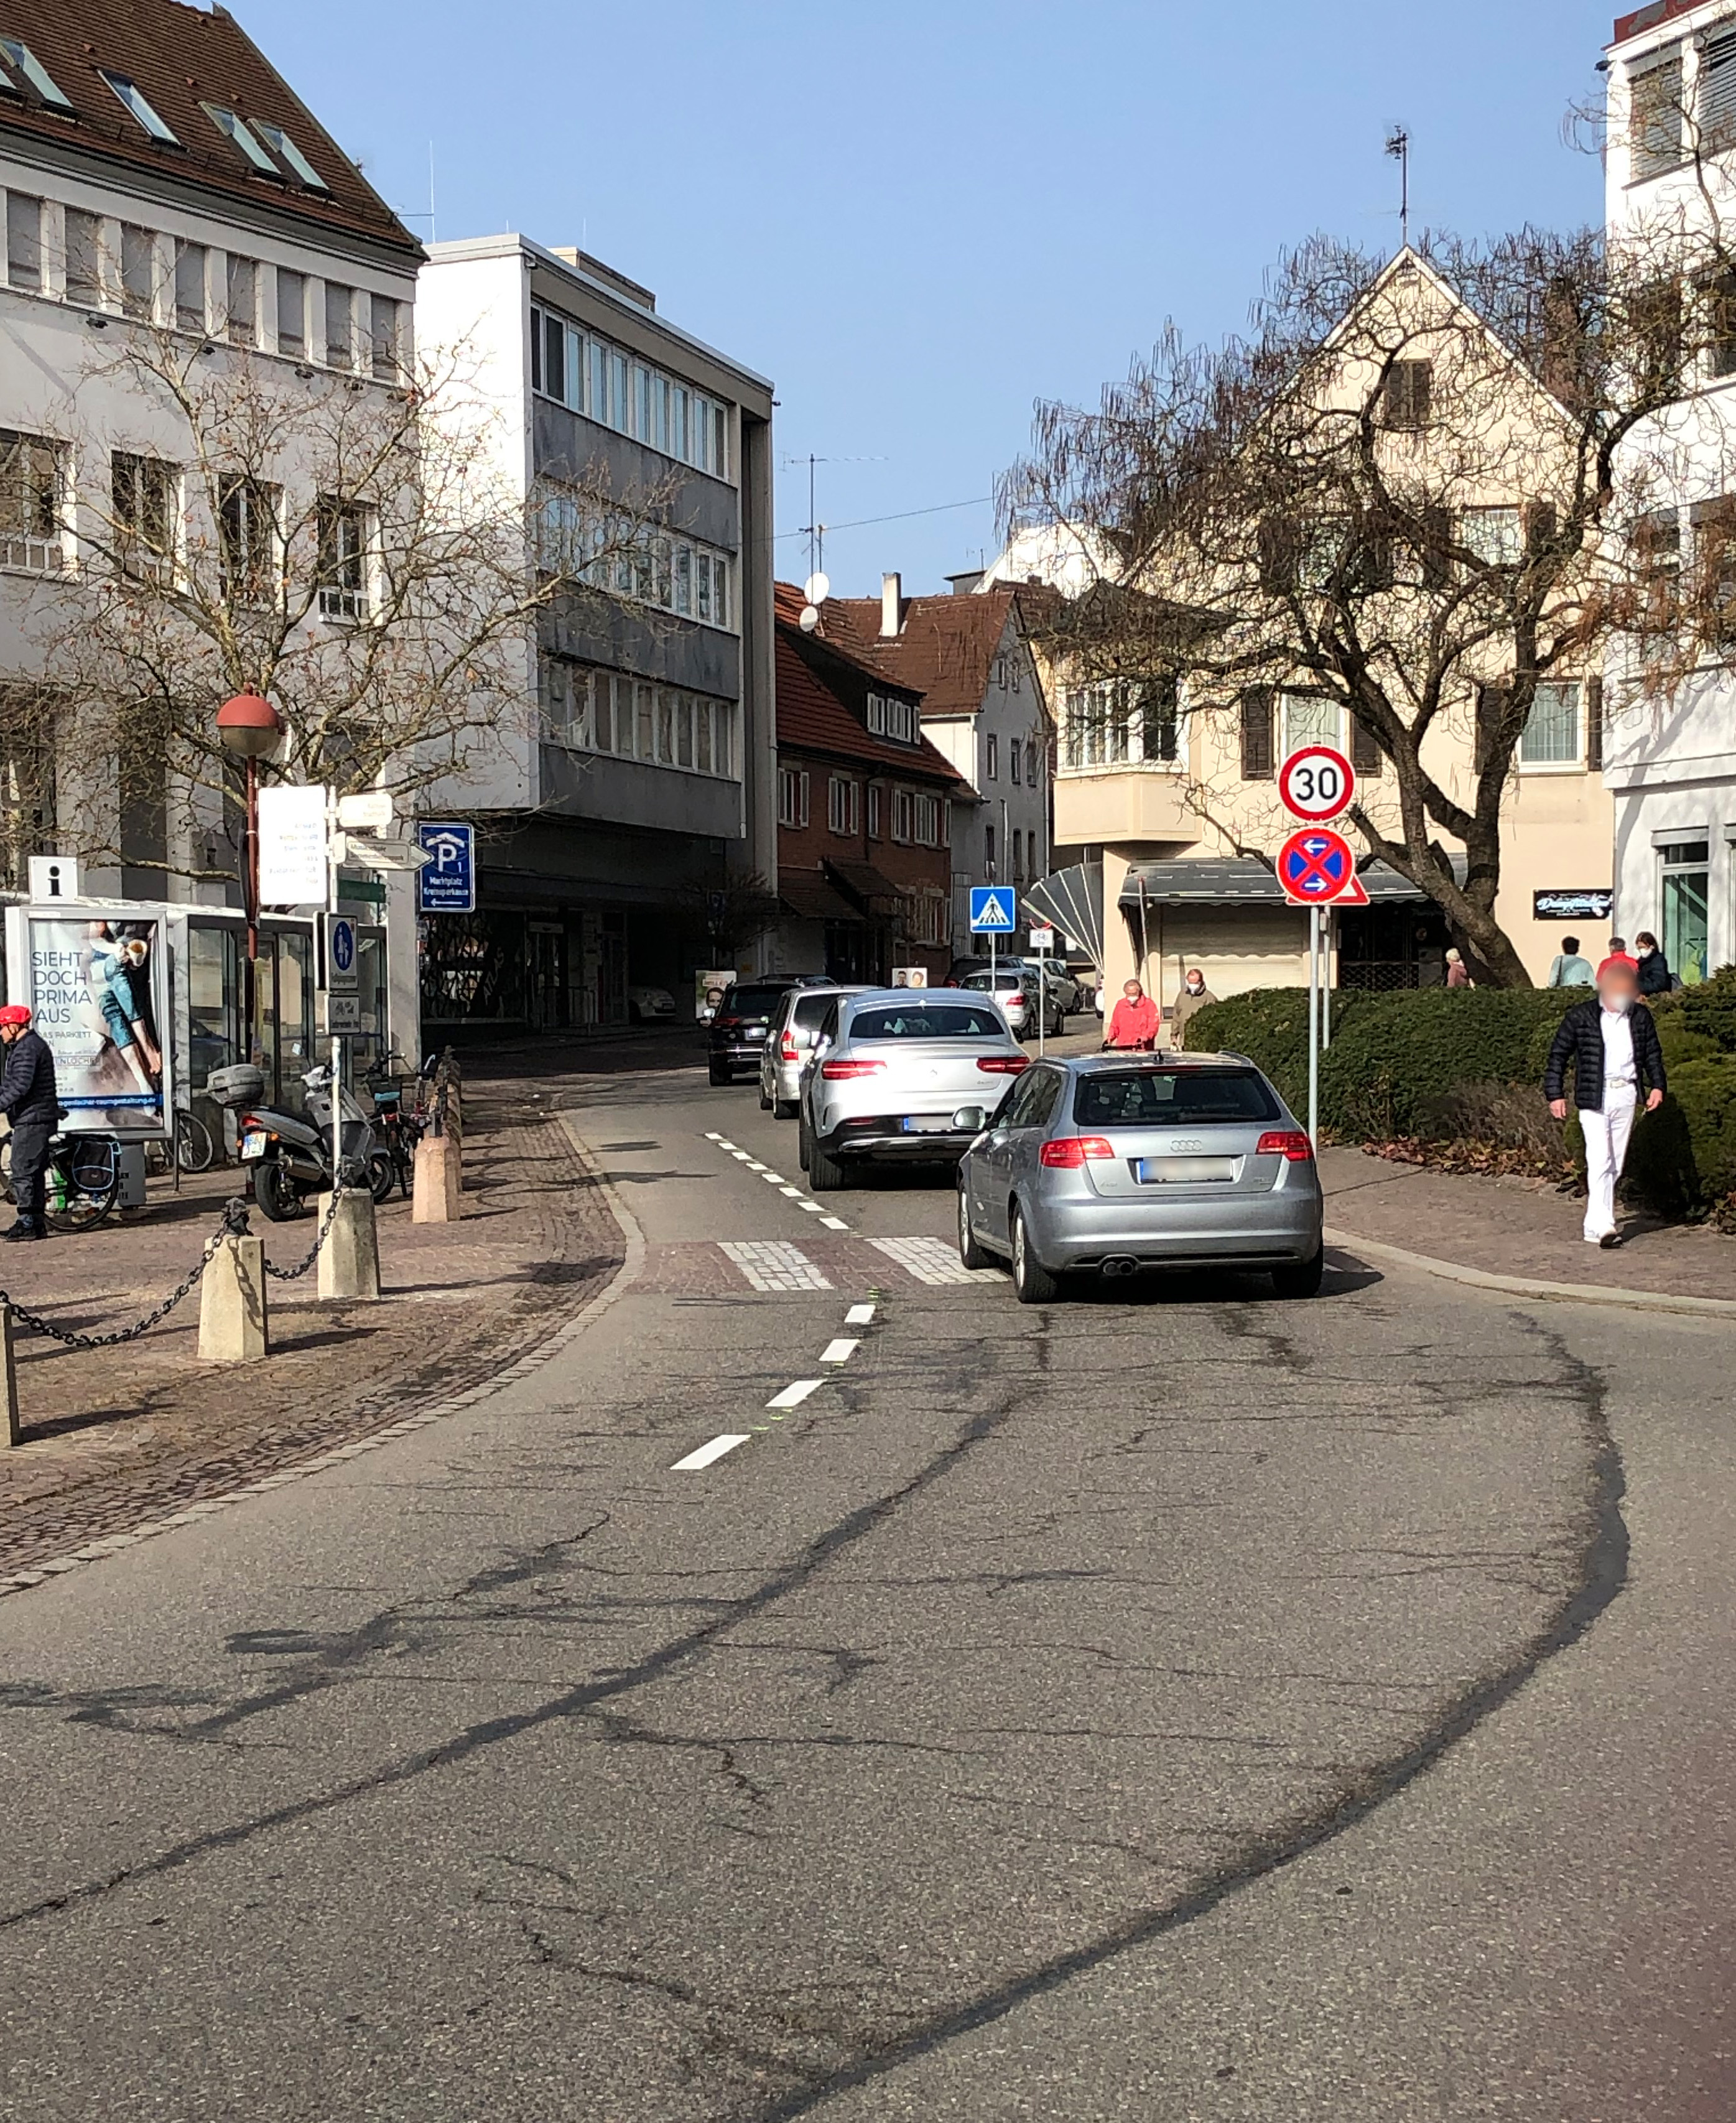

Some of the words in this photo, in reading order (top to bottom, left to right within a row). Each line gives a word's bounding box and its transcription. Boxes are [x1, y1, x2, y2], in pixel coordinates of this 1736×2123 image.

[1295, 767, 1338, 801] 30
[439, 843, 457, 872] P
[458, 862, 462, 873] 1
[429, 876, 463, 887] Marktplatz
[32, 952, 83, 967] SIEHT
[34, 970, 87, 985] DOCH
[34, 990, 93, 1005] PRIMA
[35, 1008, 71, 1023] AUS
